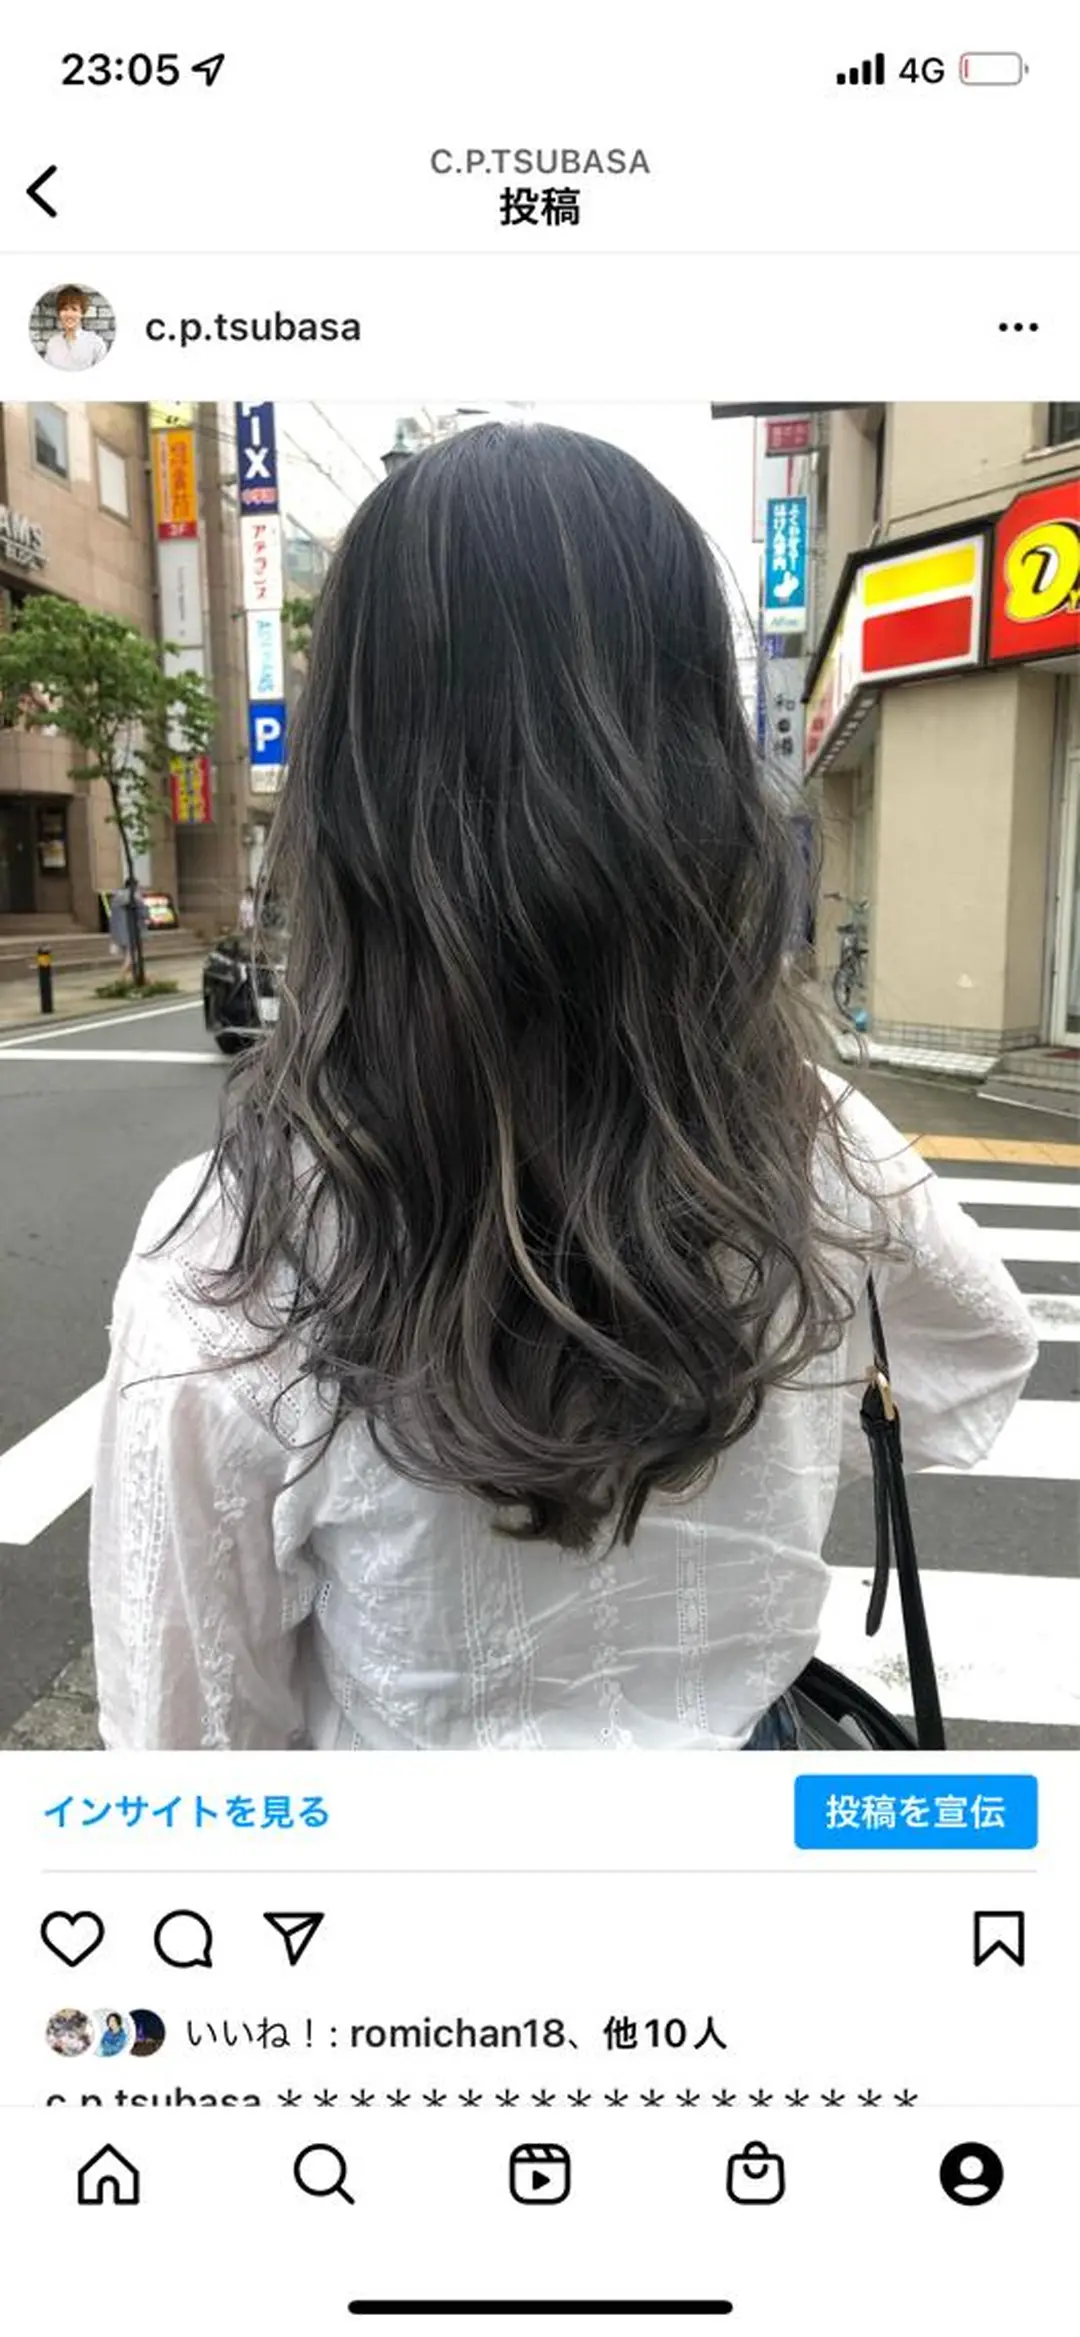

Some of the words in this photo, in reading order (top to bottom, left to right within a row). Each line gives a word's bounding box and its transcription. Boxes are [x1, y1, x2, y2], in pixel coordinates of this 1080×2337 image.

[61, 53, 180, 87] 23:05
[898, 56, 945, 84] 4G
[430, 148, 651, 175] C.P.TSUBASA
[499, 187, 581, 227] 投稿
[145, 310, 361, 349] c.p.tsubasa
[255, 717, 281, 752] P
[43, 1794, 329, 1830] インサイトを見る
[825, 1793, 1006, 1830] 投稿を宣伝
